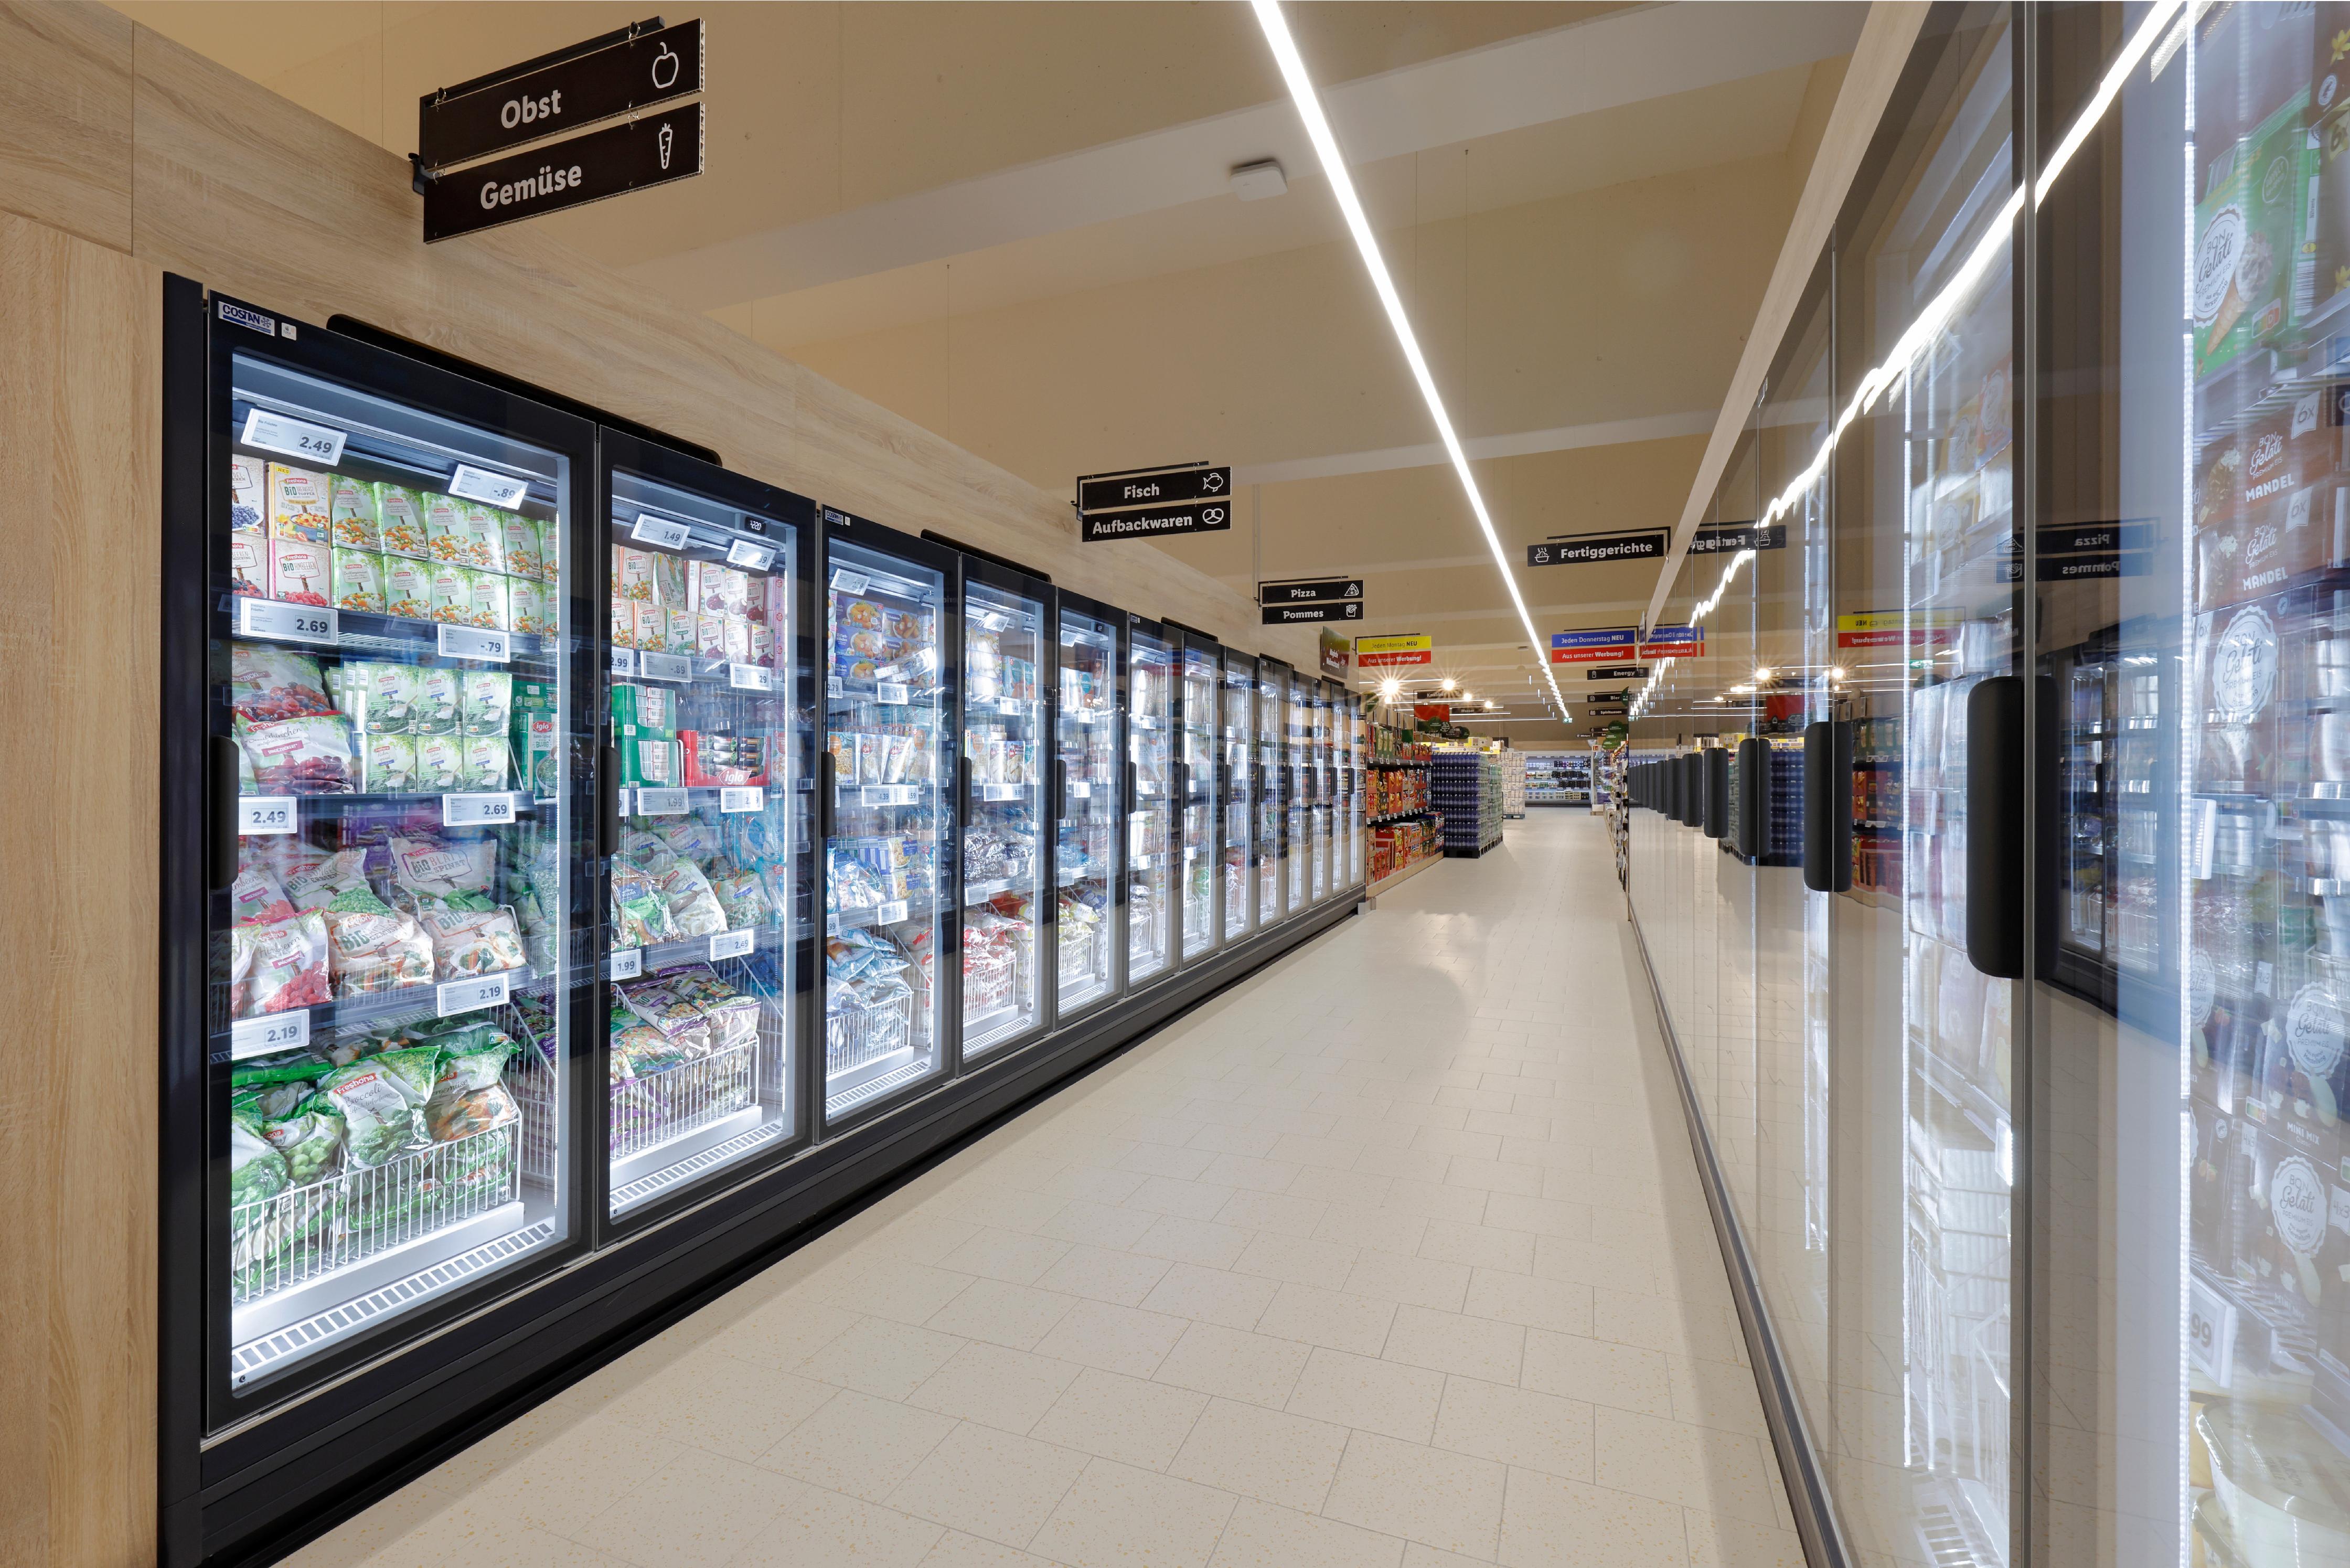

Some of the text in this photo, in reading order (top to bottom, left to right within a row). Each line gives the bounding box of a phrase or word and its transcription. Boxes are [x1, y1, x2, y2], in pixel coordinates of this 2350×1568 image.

[500, 89, 562, 130] Obst
[480, 165, 582, 210] Gemüse
[2207, 228, 2226, 254] BON
[2196, 232, 2234, 294] Gelati
[222, 304, 261, 324] COSTAN
[300, 436, 332, 453] 2.49
[2259, 431, 2278, 447] BON
[2249, 435, 2283, 475] Gelati
[2252, 457, 2283, 479] PREMIUM EIS
[1124, 483, 1160, 499] Fisch
[2246, 473, 2295, 502] MANDEL
[1093, 516, 1192, 535] Aufbackwaren
[2255, 522, 2271, 537] BON
[664, 531, 680, 541] 1.49
[1561, 542, 1653, 559] Fertiggerichte
[2245, 527, 2277, 564] Gelati
[2249, 549, 2278, 569] PREMIUM EIS
[2242, 566, 2289, 591] MANDEL
[1291, 589, 1316, 598] Pizza
[1283, 609, 1324, 620] Pommes
[296, 618, 328, 633] 2.69
[2234, 631, 2256, 647] BON
[480, 642, 501, 653] -.79
[670, 665, 685, 674] -.89
[536, 722, 549, 731] iglo
[724, 769, 744, 786] iglo
[484, 805, 507, 815] 2.69
[667, 798, 682, 807] 1.99
[253, 811, 286, 823] 2.49
[288, 864, 317, 875] Freshon
[410, 859, 431, 873] BiO
[617, 961, 635, 971] 1.99
[479, 986, 501, 999] 2.19
[2307, 1001, 2325, 1016] BON
[268, 1026, 297, 1042] 2.19
[337, 1074, 374, 1094] Freshona
[344, 1082, 382, 1106] Broccoli
[2287, 1122, 2320, 1146] MINI MIX
[2289, 1174, 2308, 1191] BON
[2280, 1186, 2315, 1214] Gelati
